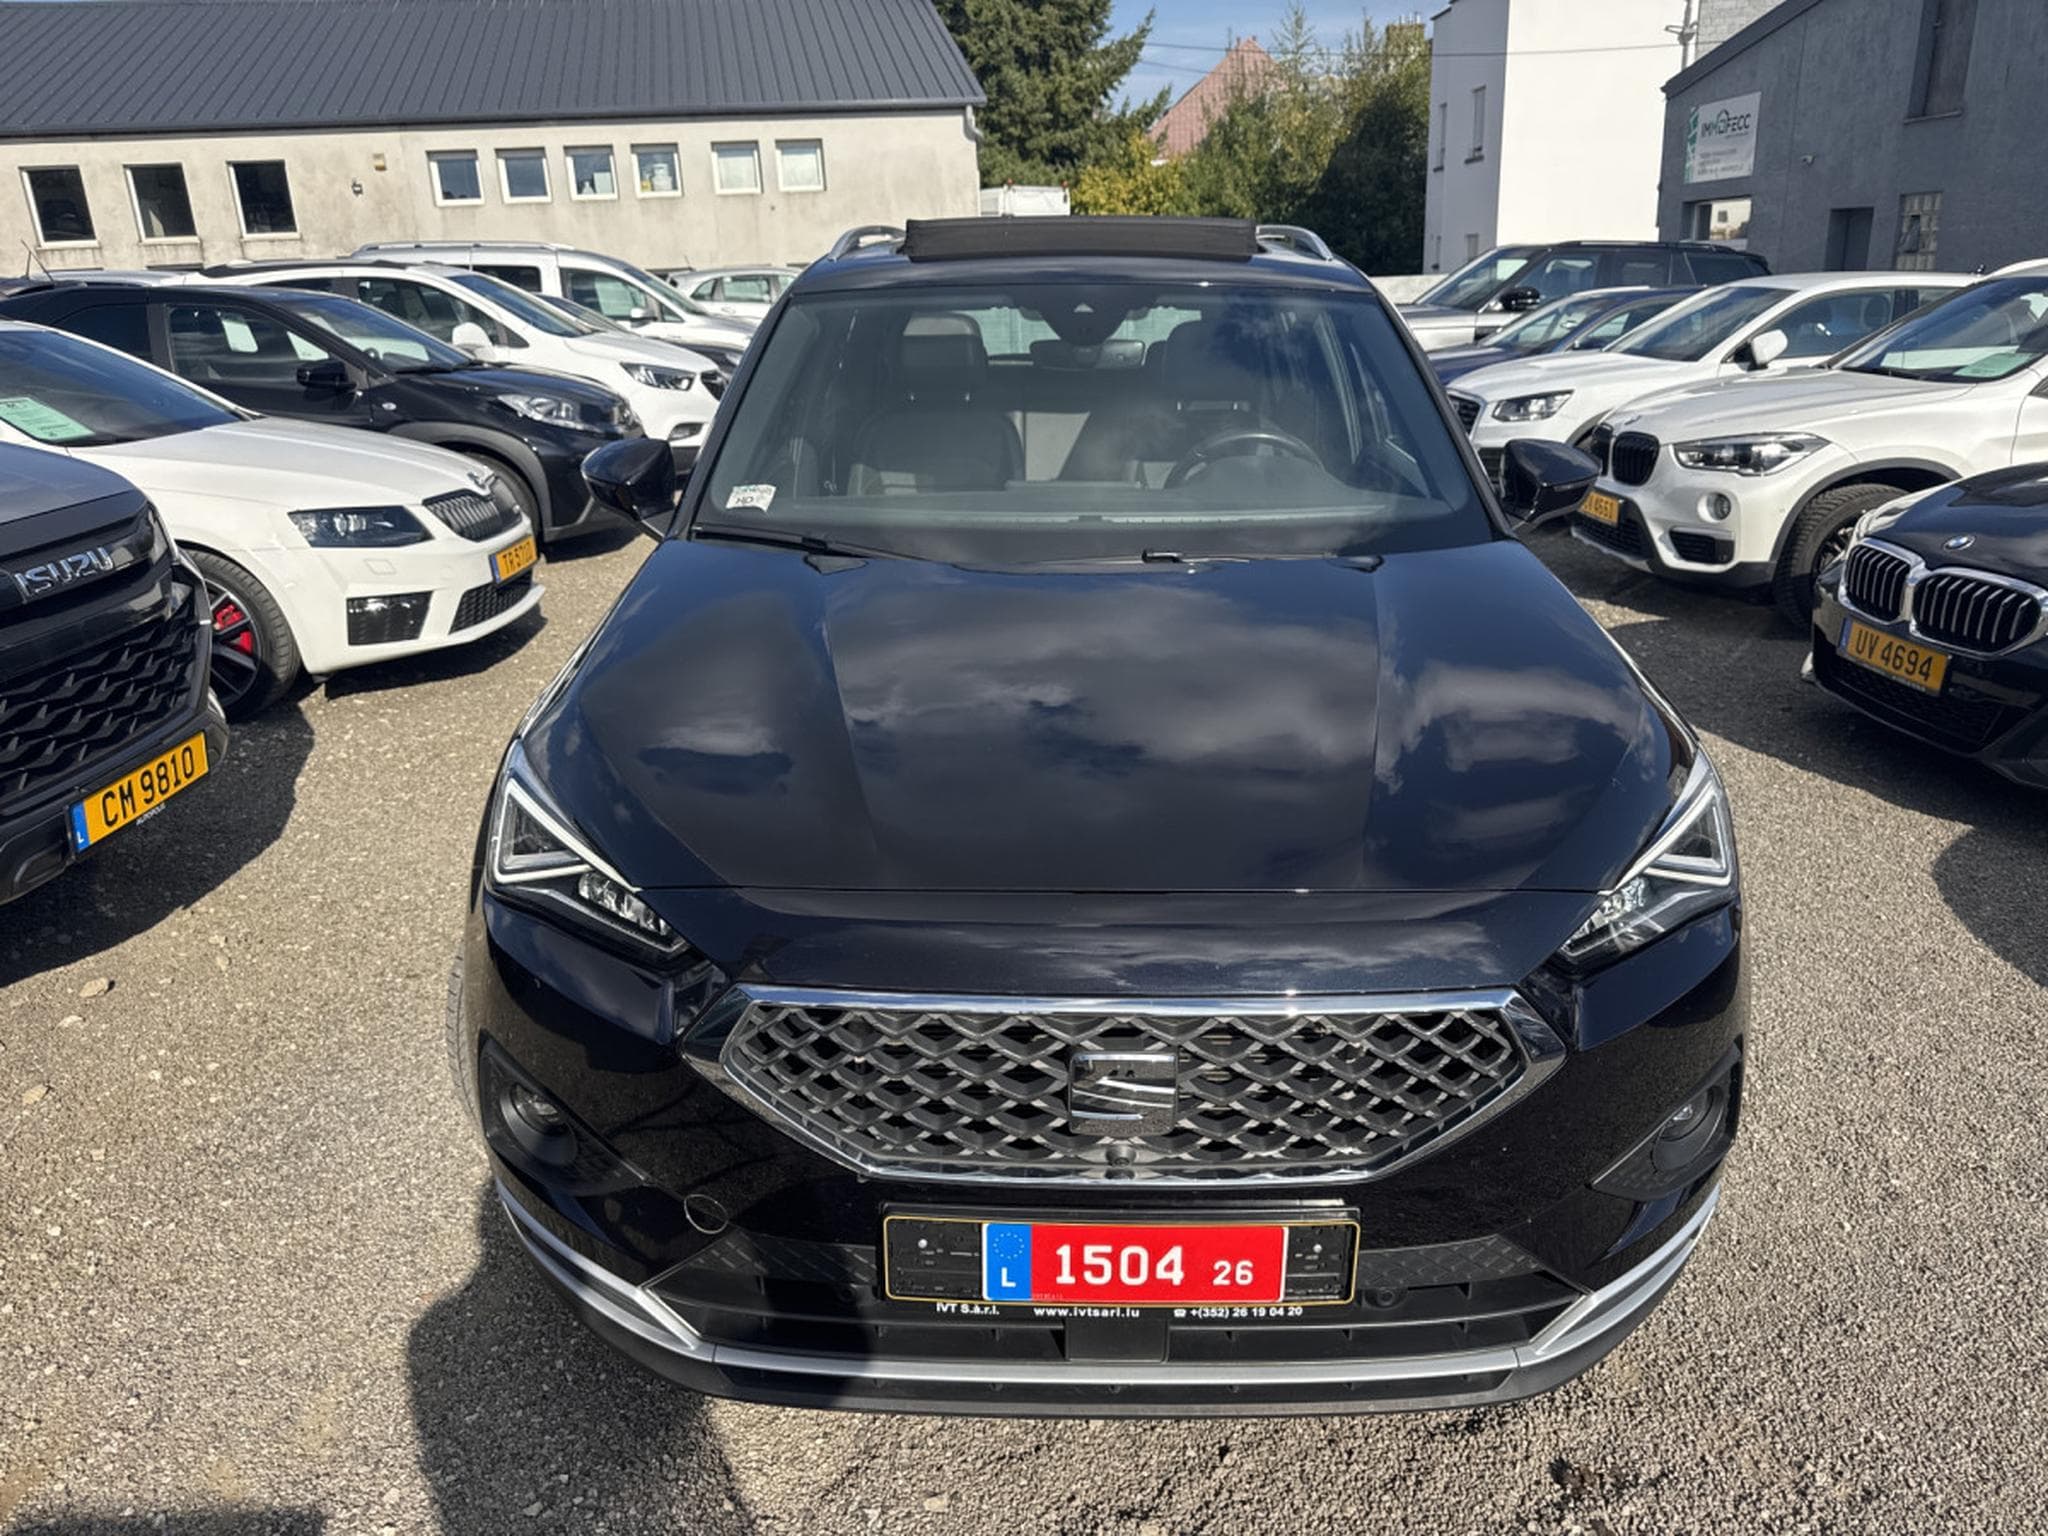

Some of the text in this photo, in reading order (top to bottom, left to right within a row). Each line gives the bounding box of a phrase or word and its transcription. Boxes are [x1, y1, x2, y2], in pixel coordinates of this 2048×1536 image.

[14, 547, 114, 604] ISUZU
[1856, 629, 1934, 682] UV 4694
[76, 831, 85, 844] L
[101, 780, 137, 828] CM
[140, 745, 195, 805] 9810
[1001, 1244, 1254, 1288] L 1504 26
[936, 1303, 957, 1313] IVT
[1033, 1307, 1140, 1318] www.ivtsarl.lu
[1190, 1307, 1230, 1319] +(352)
[1232, 1307, 1248, 1318] 26
[1252, 1306, 1266, 1317] 19
[1287, 1305, 1303, 1316] 20
